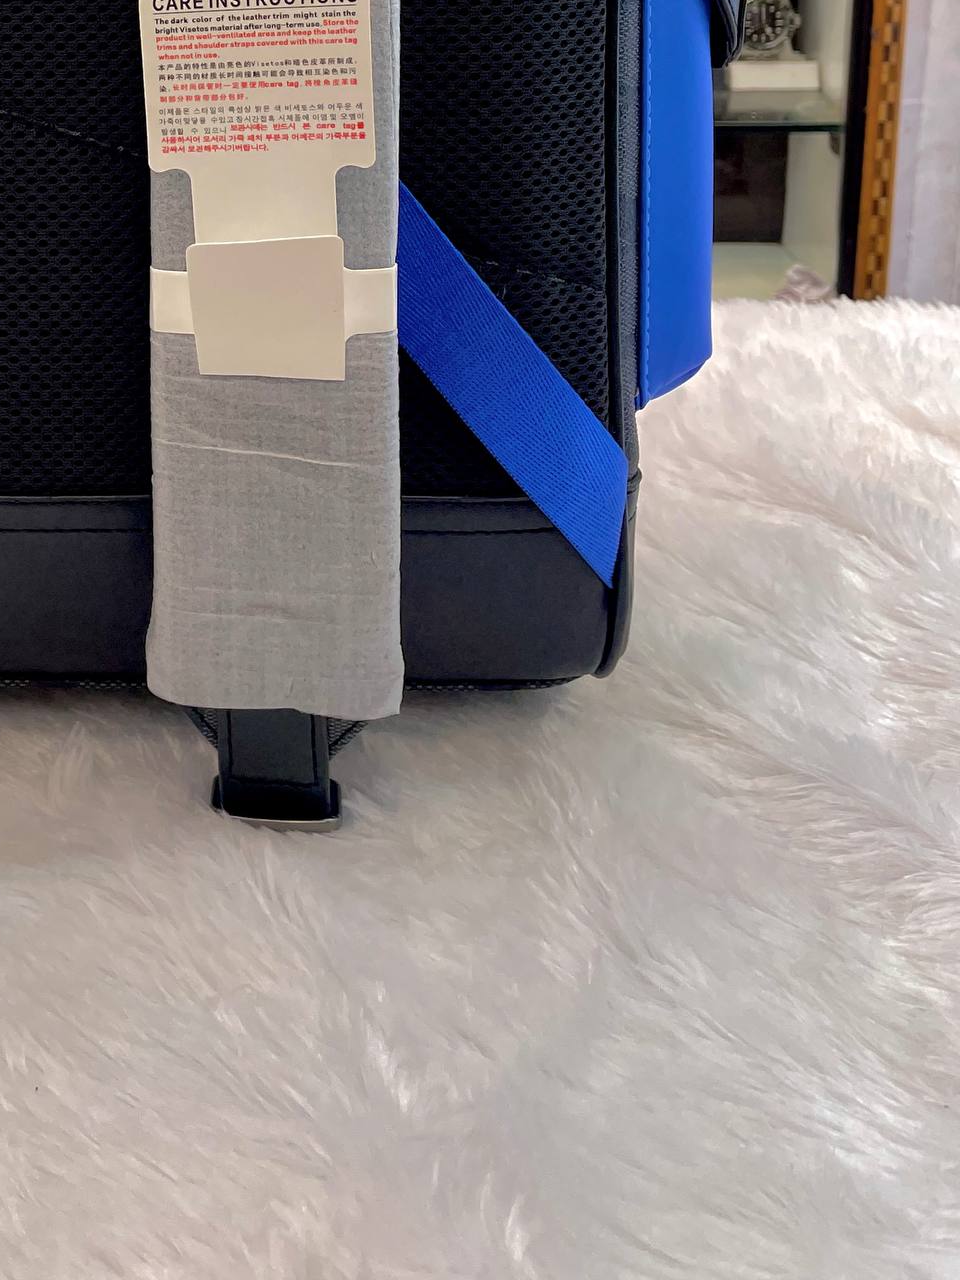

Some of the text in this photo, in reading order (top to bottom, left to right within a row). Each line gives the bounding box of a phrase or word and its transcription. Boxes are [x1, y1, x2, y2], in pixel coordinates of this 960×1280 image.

[264, 22, 304, 30] long-term
[156, 34, 186, 43] product
[196, 31, 256, 40] well-ventilated
[344, 37, 357, 45] tag
